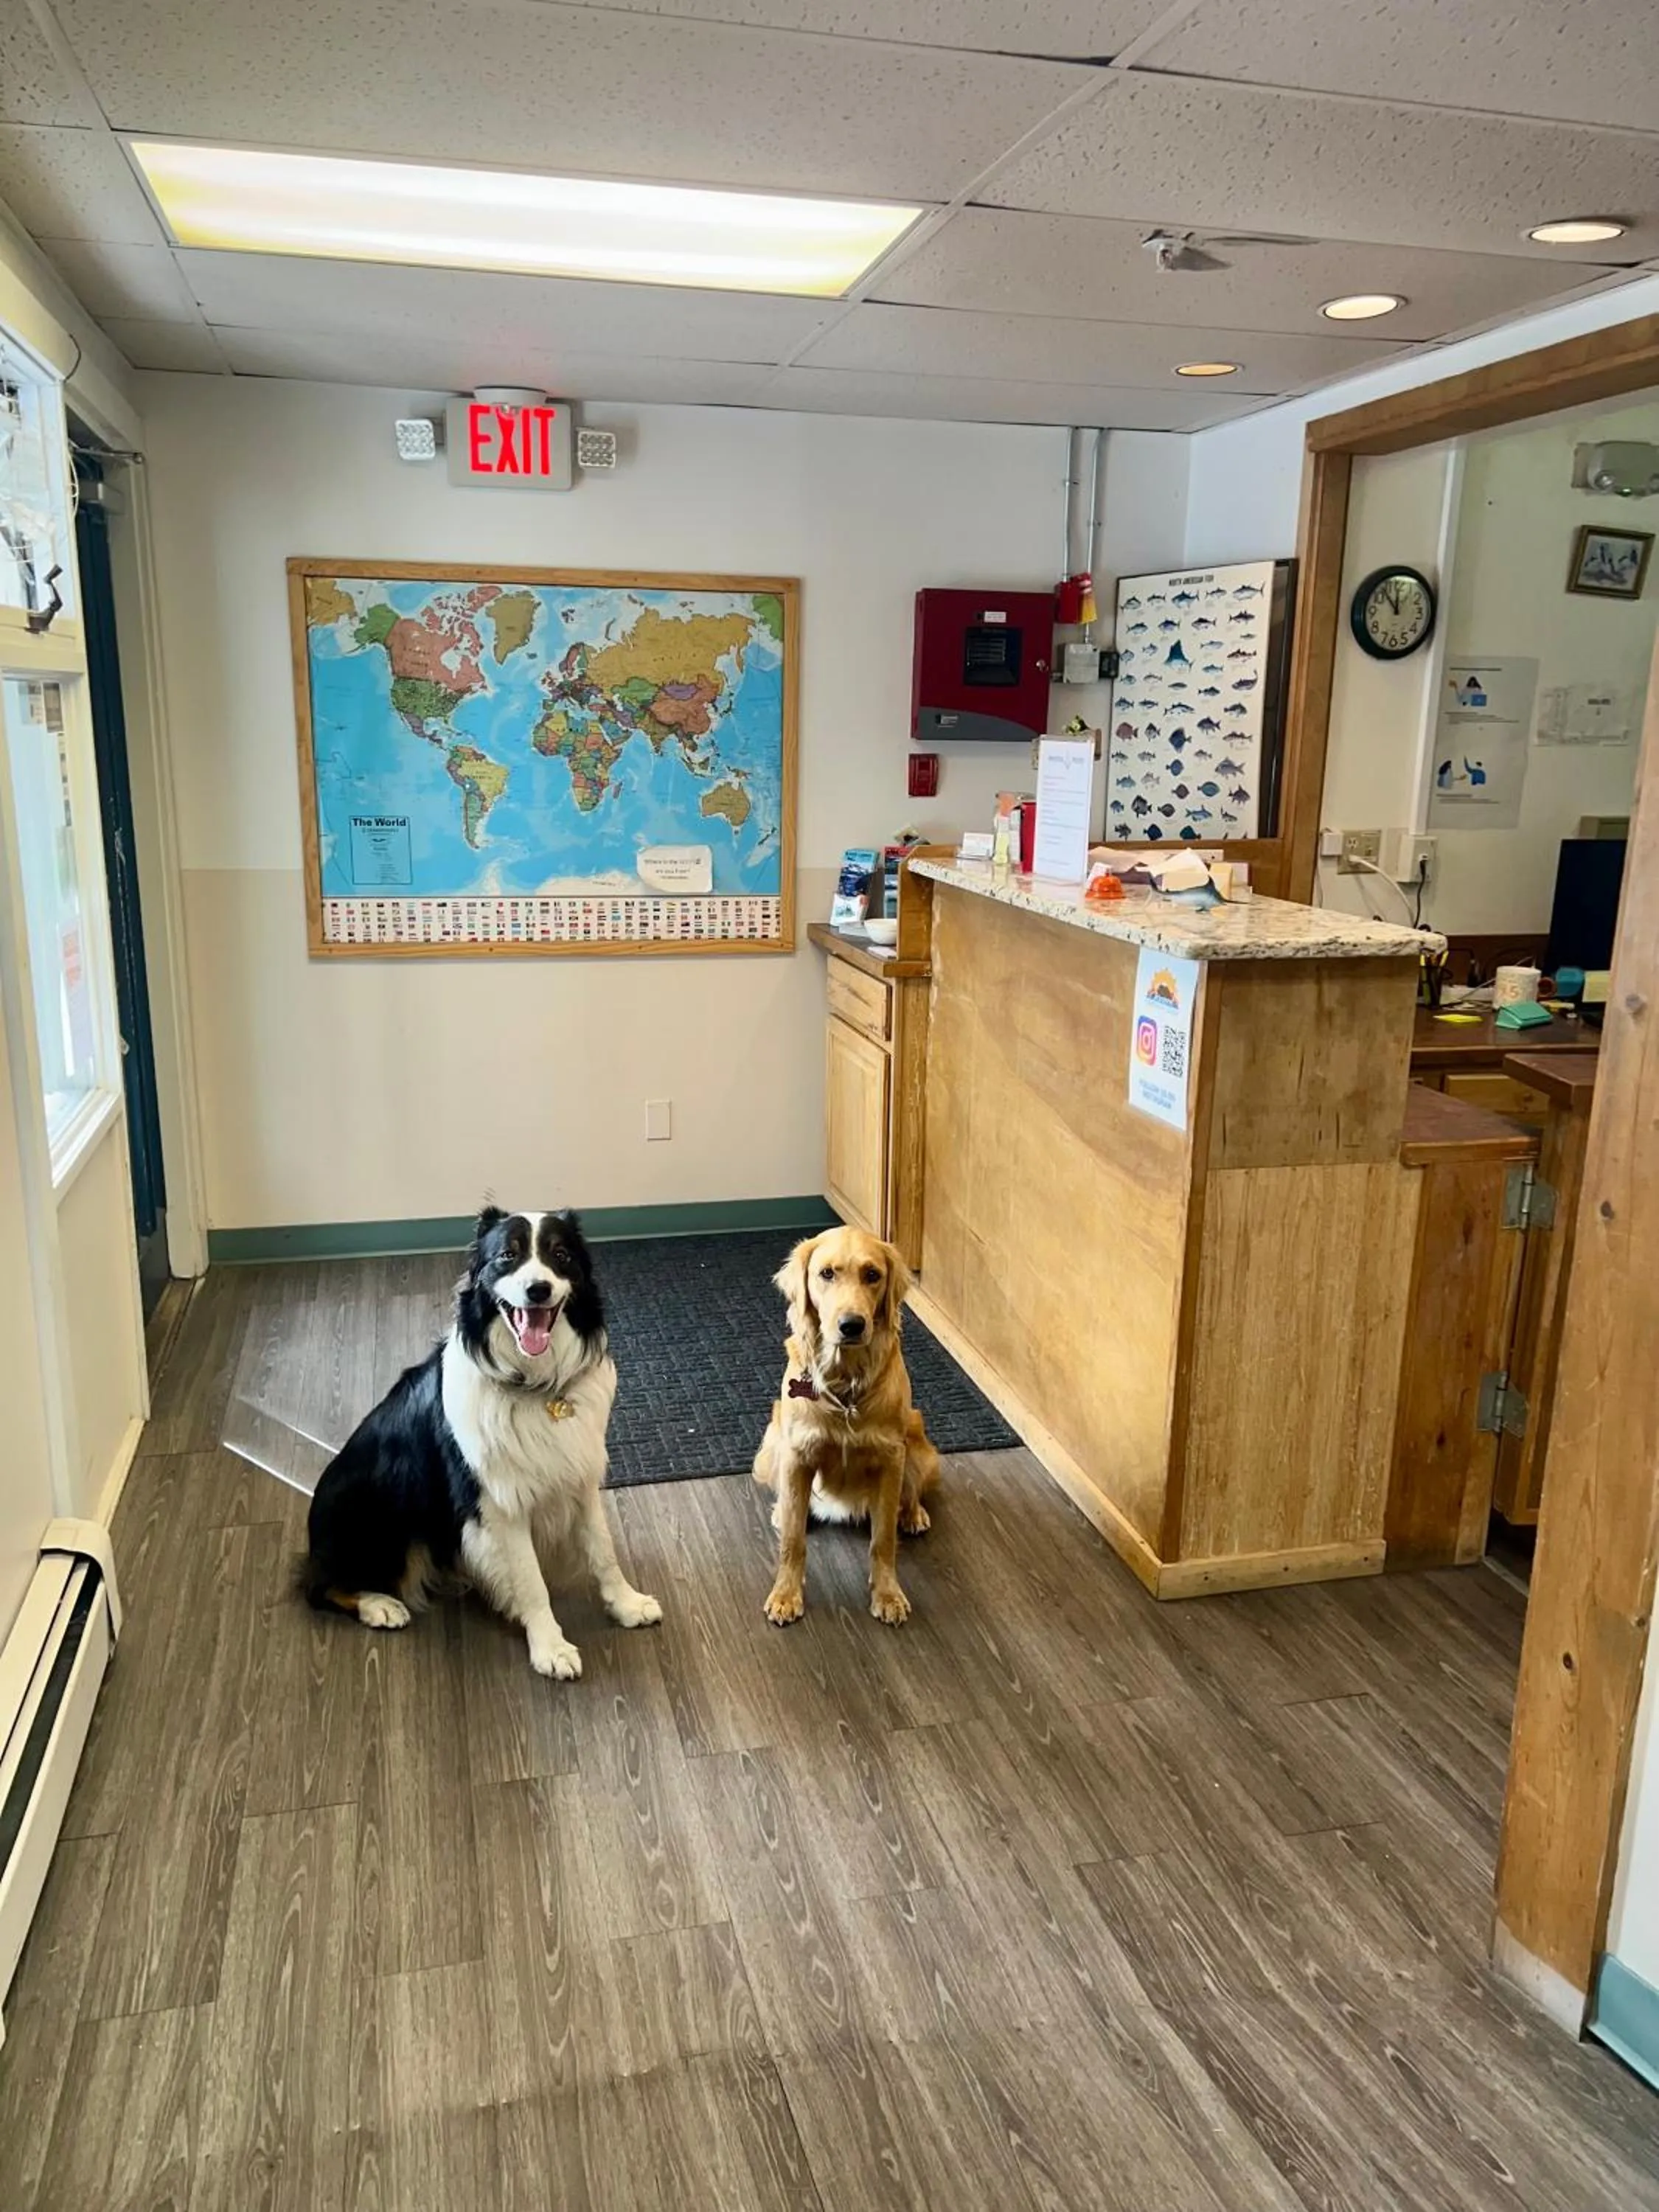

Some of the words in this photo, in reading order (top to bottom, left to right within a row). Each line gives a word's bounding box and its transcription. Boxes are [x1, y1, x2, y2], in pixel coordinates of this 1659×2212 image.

[468, 403, 554, 475] EXIT
[352, 818, 372, 827] The
[374, 818, 406, 827] World
